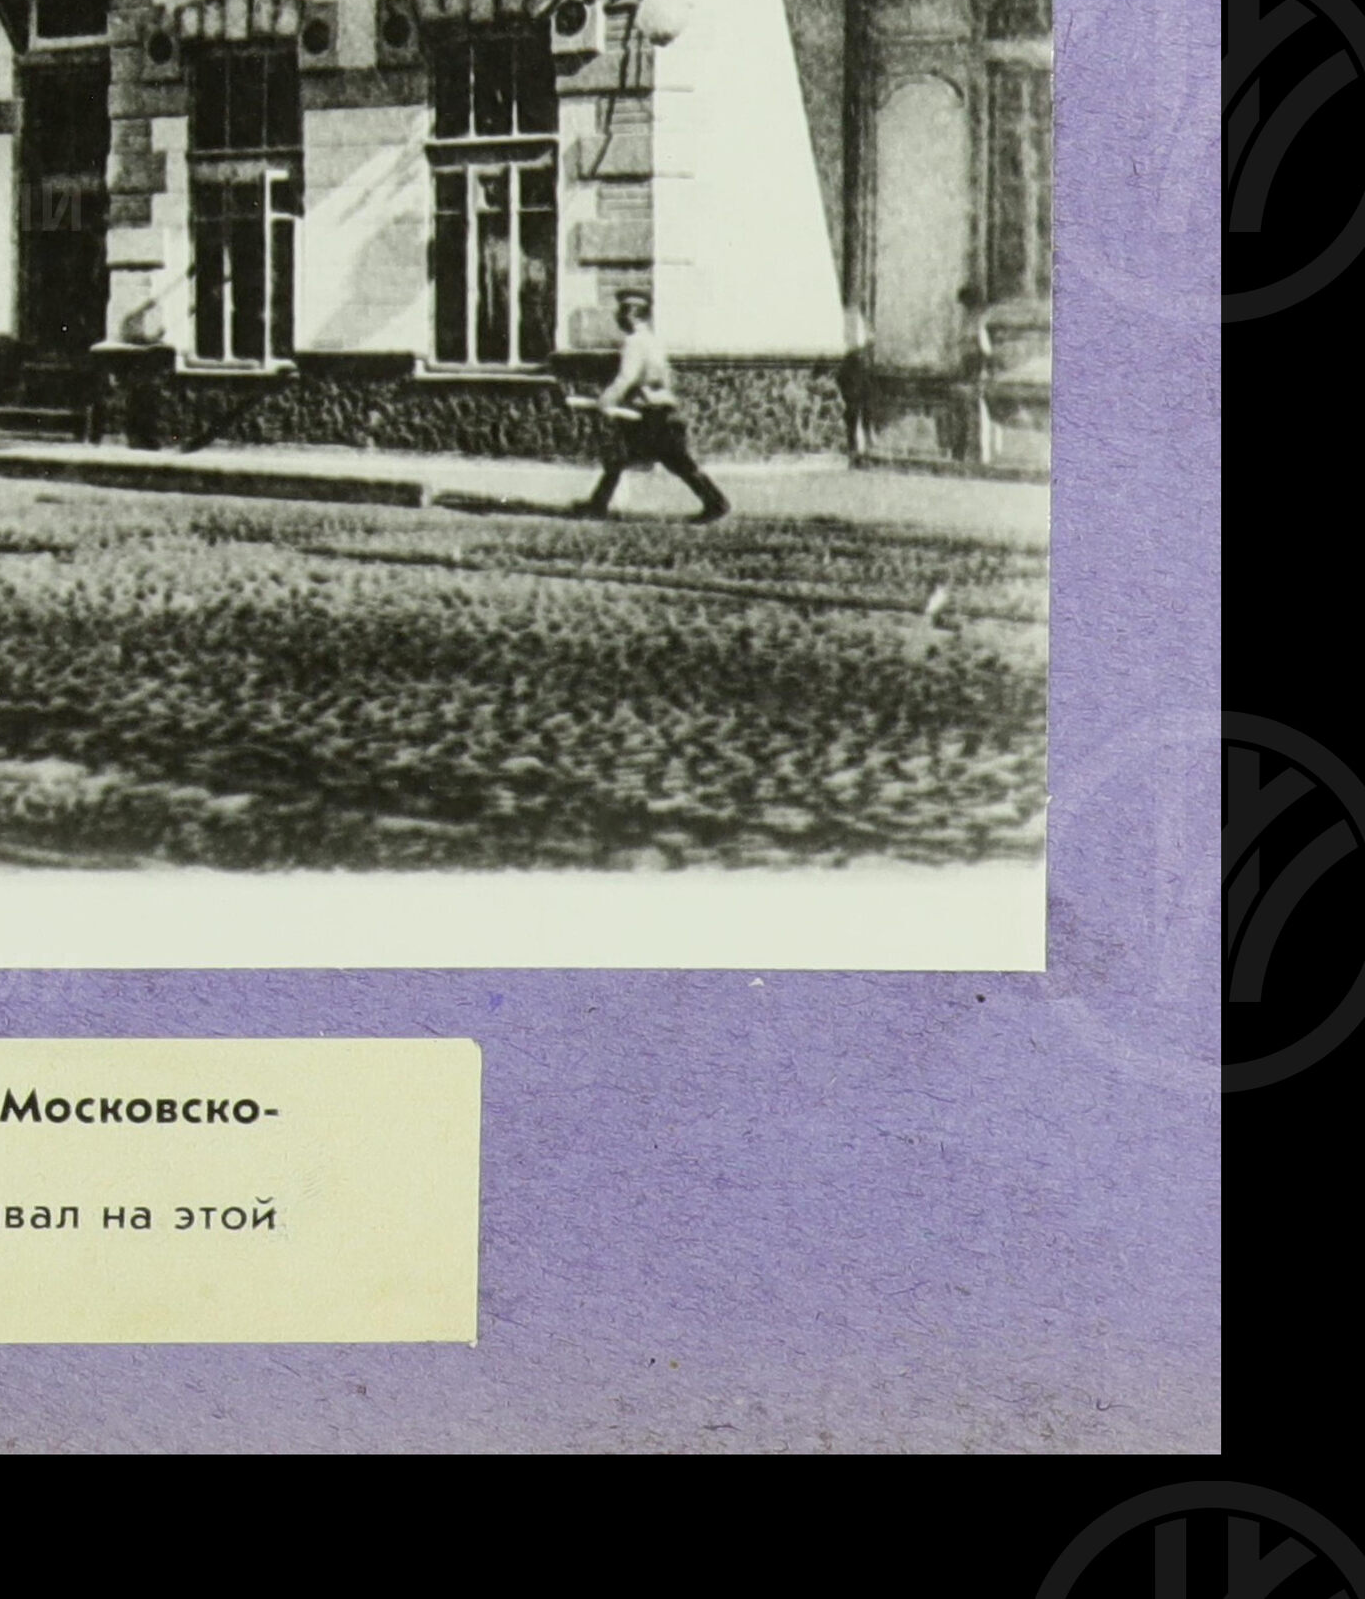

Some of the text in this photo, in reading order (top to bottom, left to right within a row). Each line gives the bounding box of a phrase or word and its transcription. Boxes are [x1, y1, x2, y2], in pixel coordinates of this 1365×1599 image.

[0, 1088, 279, 1125] Московско-
[103, 1206, 152, 1230] на
[175, 1197, 276, 1231] этой
